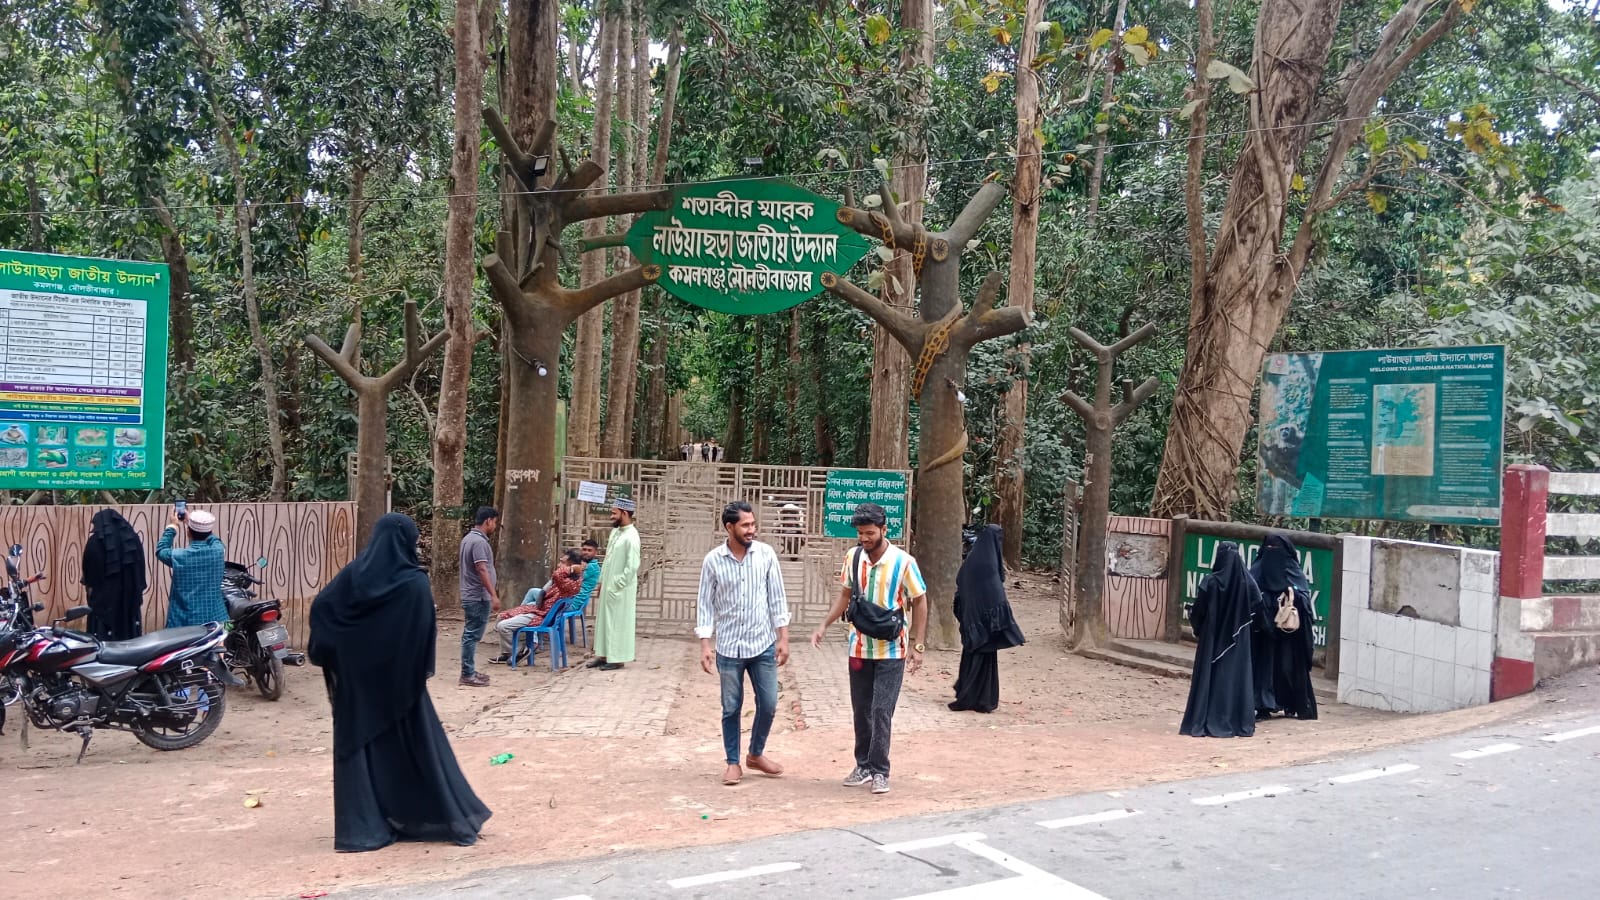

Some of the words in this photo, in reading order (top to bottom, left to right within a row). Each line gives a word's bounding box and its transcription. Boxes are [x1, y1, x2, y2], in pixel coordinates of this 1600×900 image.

[682, 191, 753, 218] শতাব্দীর
[757, 199, 814, 222] স্মারক
[653, 216, 734, 265] লাউয়াছড়া
[735, 224, 789, 264] জাতীয়
[789, 226, 839, 264] উদ্যান
[67, 265, 112, 283] জাতীয়
[115, 269, 155, 287] উদ্যান
[727, 263, 813, 291] মৌলভীবাজার
